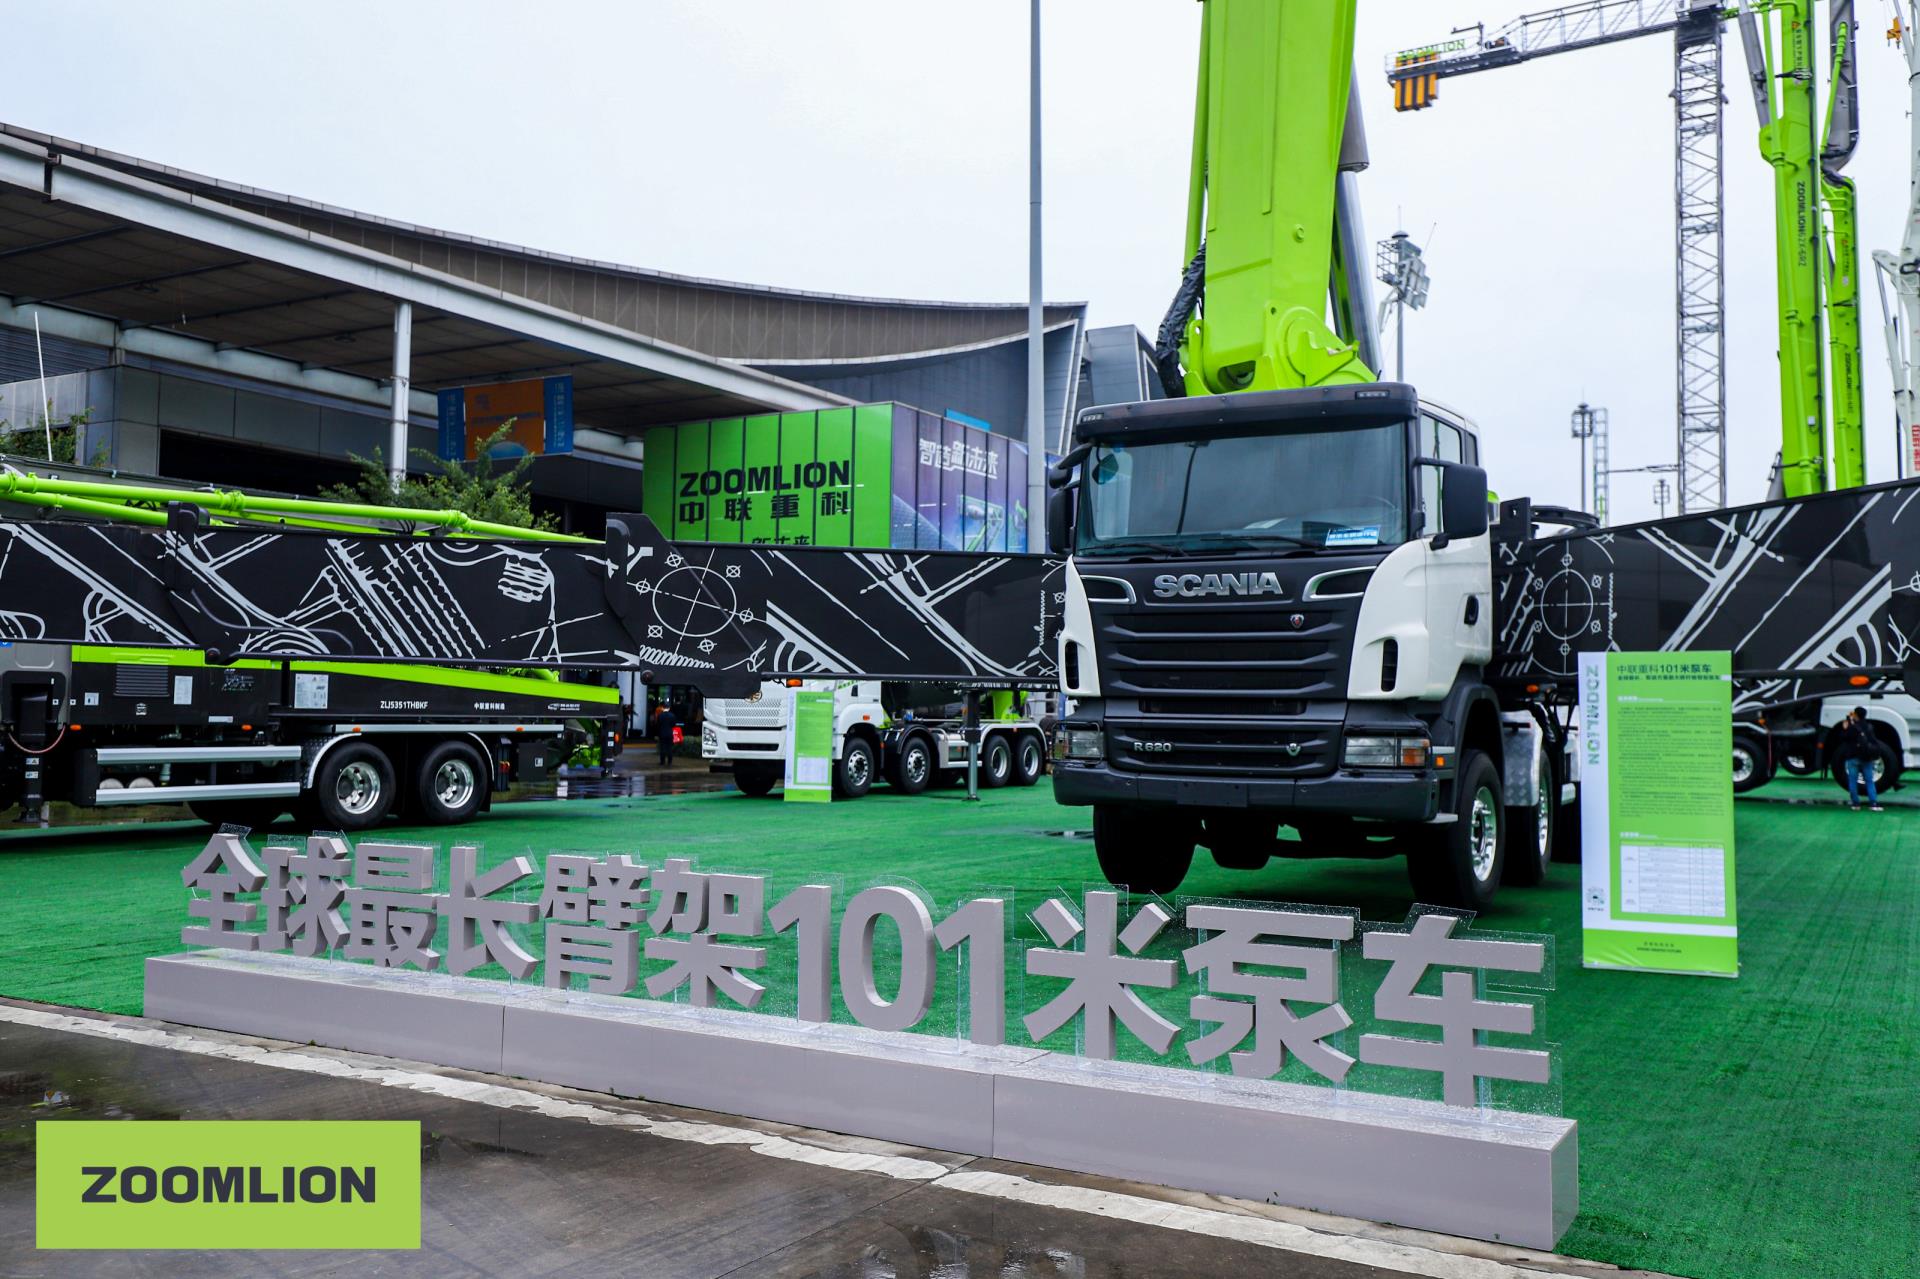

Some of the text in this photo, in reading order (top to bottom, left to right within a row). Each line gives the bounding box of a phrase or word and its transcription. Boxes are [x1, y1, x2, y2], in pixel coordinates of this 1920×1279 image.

[680, 460, 850, 498] ZOOMLION
[679, 491, 849, 524] 中联重科
[1153, 572, 1283, 598] SCANIA
